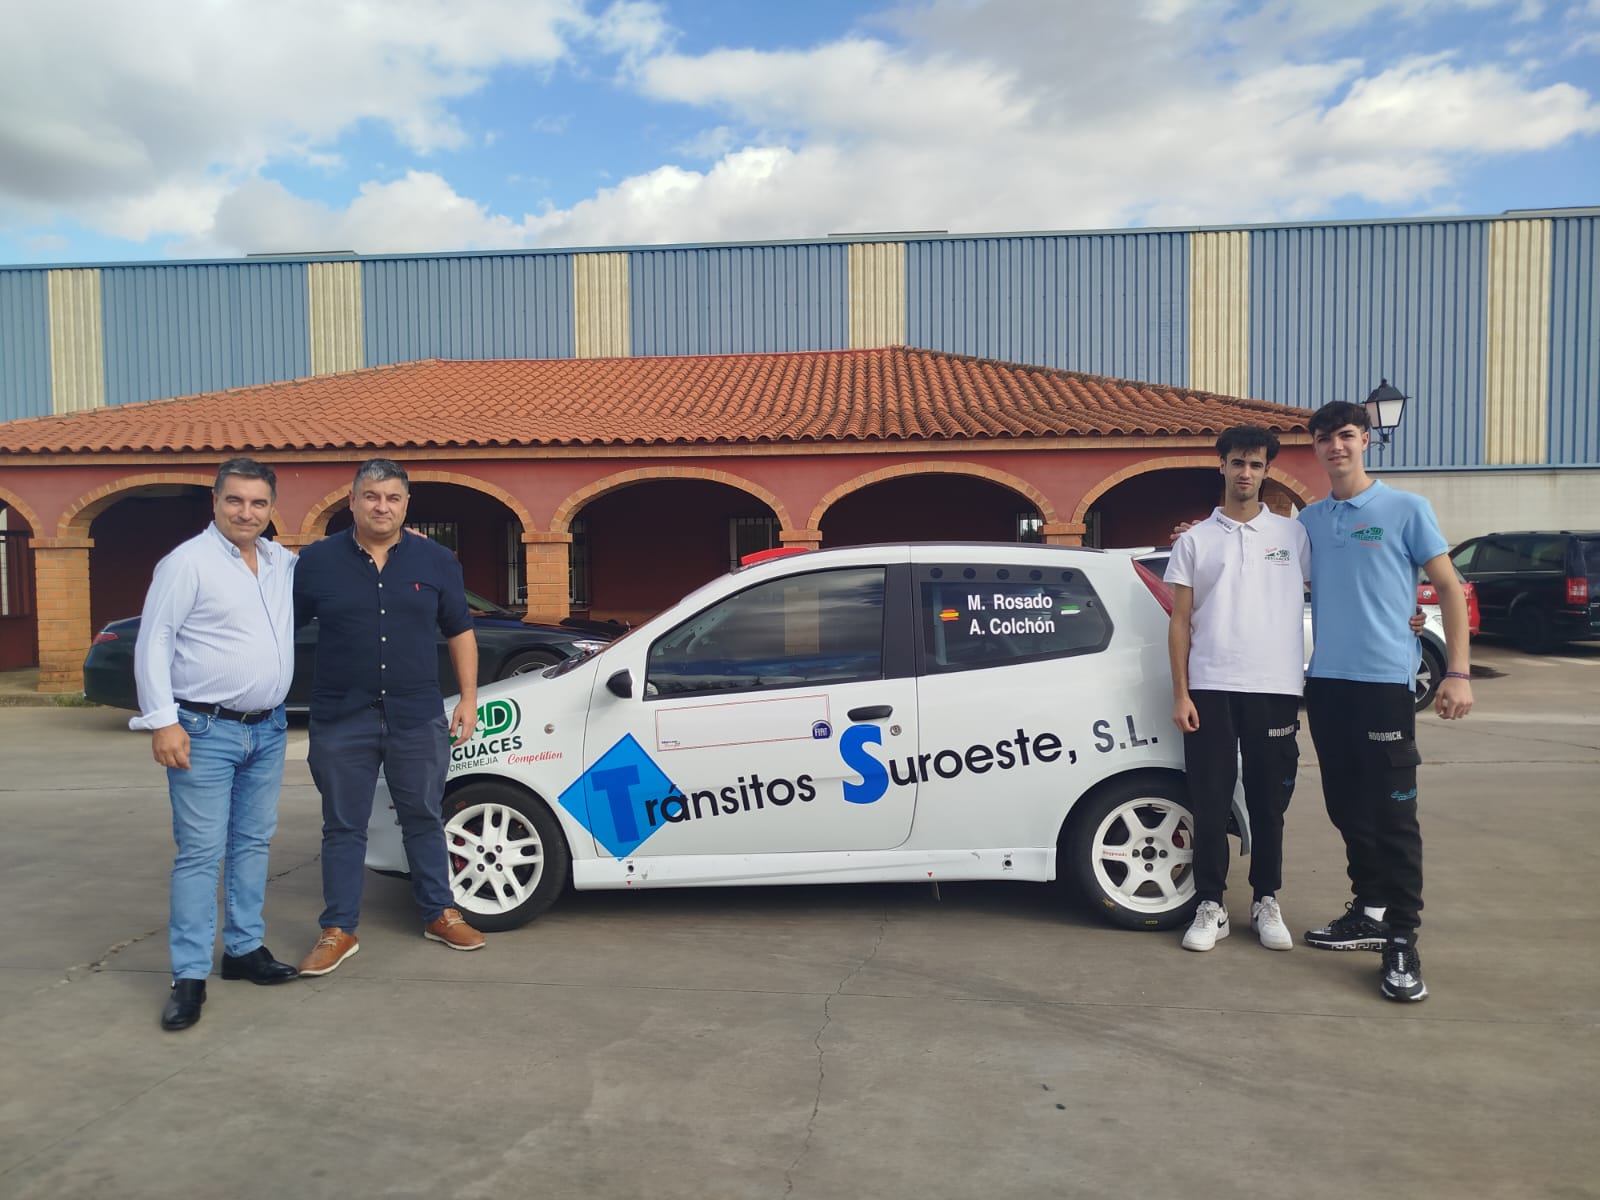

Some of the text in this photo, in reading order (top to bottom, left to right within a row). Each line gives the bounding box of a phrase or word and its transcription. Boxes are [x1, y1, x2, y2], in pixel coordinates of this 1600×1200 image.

[967, 593, 1053, 611] M. Rosado
[969, 616, 1056, 635] A. Colchón
[1092, 714, 1159, 753] S.L.
[451, 735, 523, 762] GUACES
[448, 756, 499, 773] ORREMEJIA
[507, 750, 563, 766] Competition
